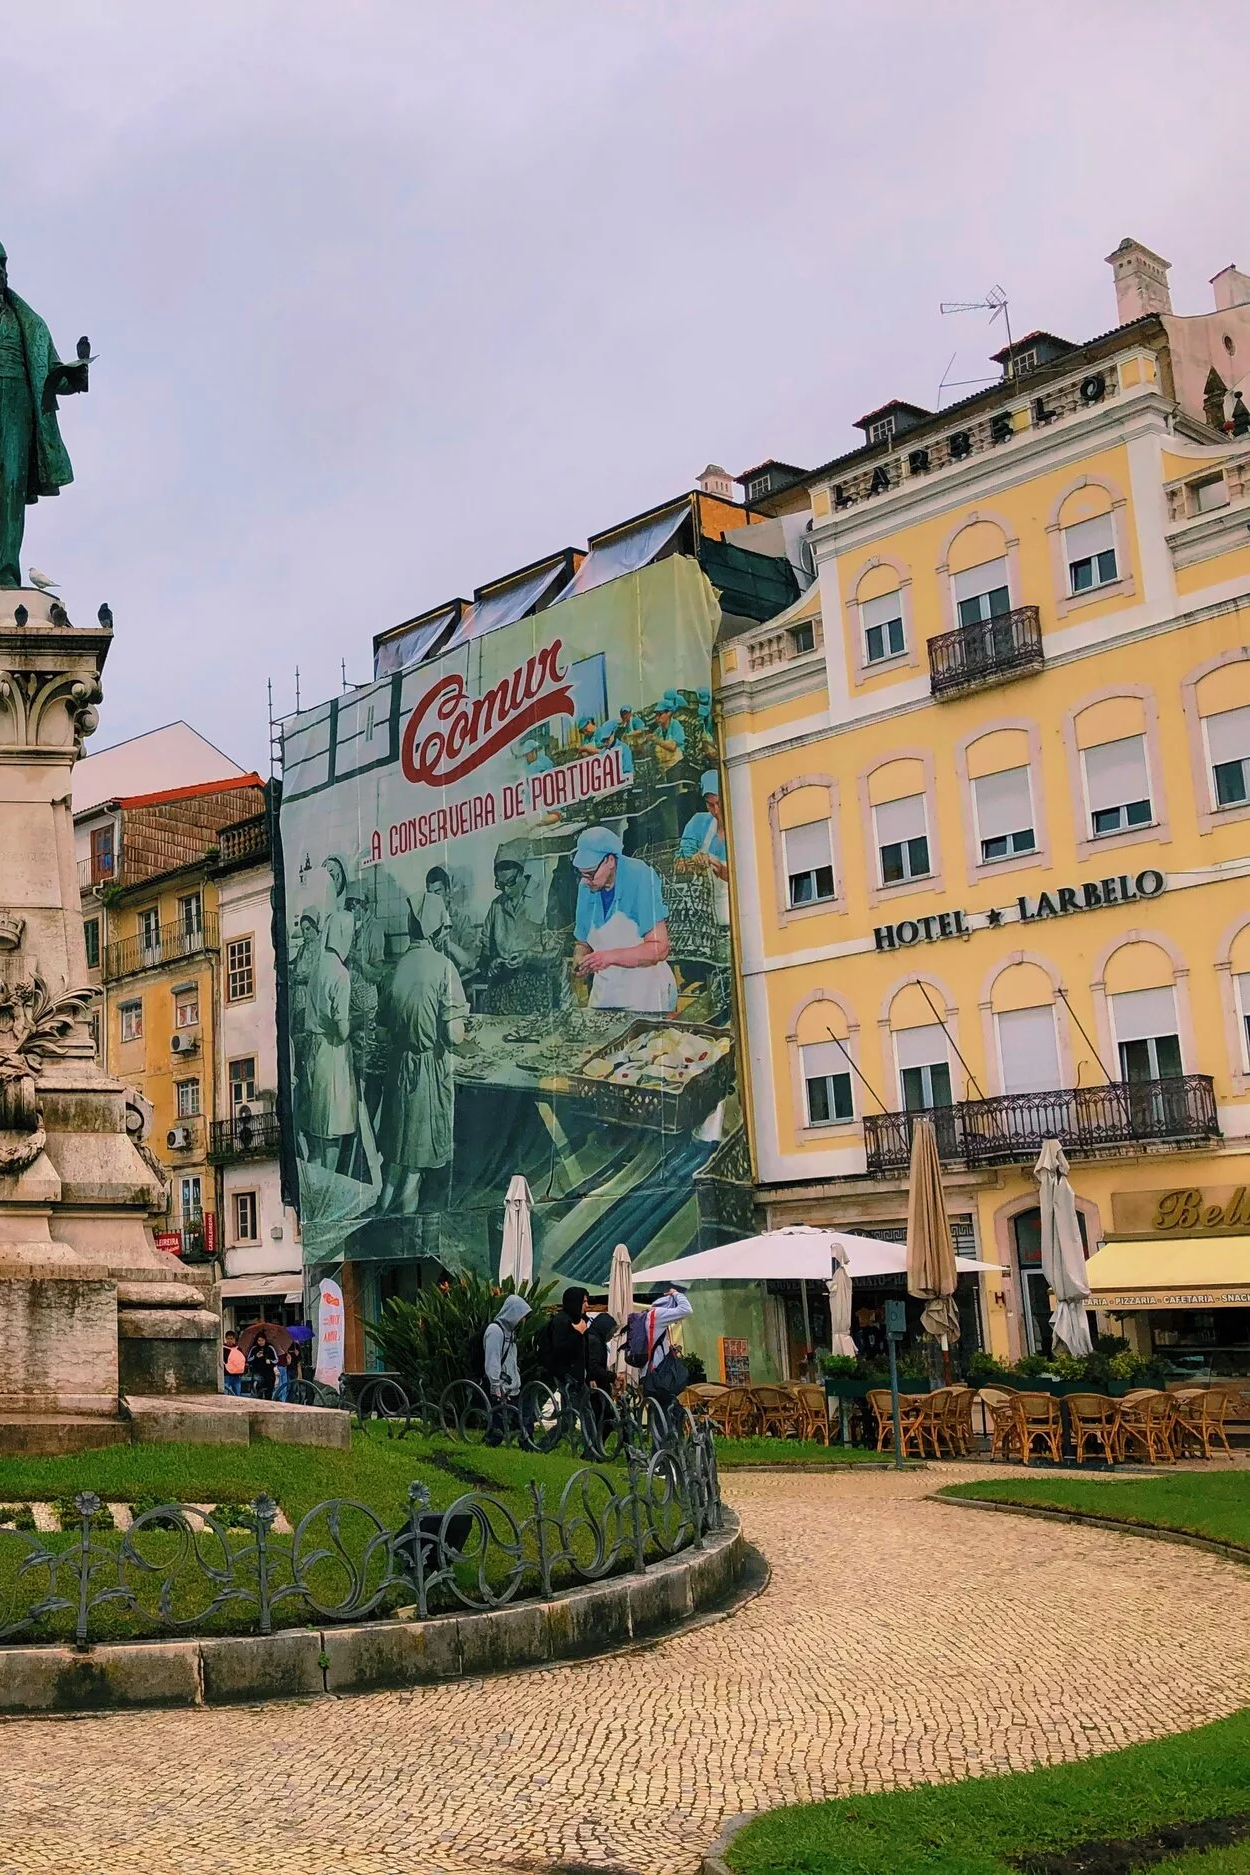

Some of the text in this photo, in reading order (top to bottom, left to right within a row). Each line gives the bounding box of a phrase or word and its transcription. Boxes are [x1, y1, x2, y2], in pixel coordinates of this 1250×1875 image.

[835, 375, 1106, 508] LARBELO
[401, 638, 571, 787] Comur
[389, 792, 496, 857] CONSERVEIRA
[503, 781, 526, 821] DE
[873, 869, 1165, 950] HOTEL LARBELO
[1156, 1187, 1250, 1229] Bel
[1115, 1295, 1156, 1306] PIZZARIA
[1163, 1294, 1215, 1305] CAFETARIA
